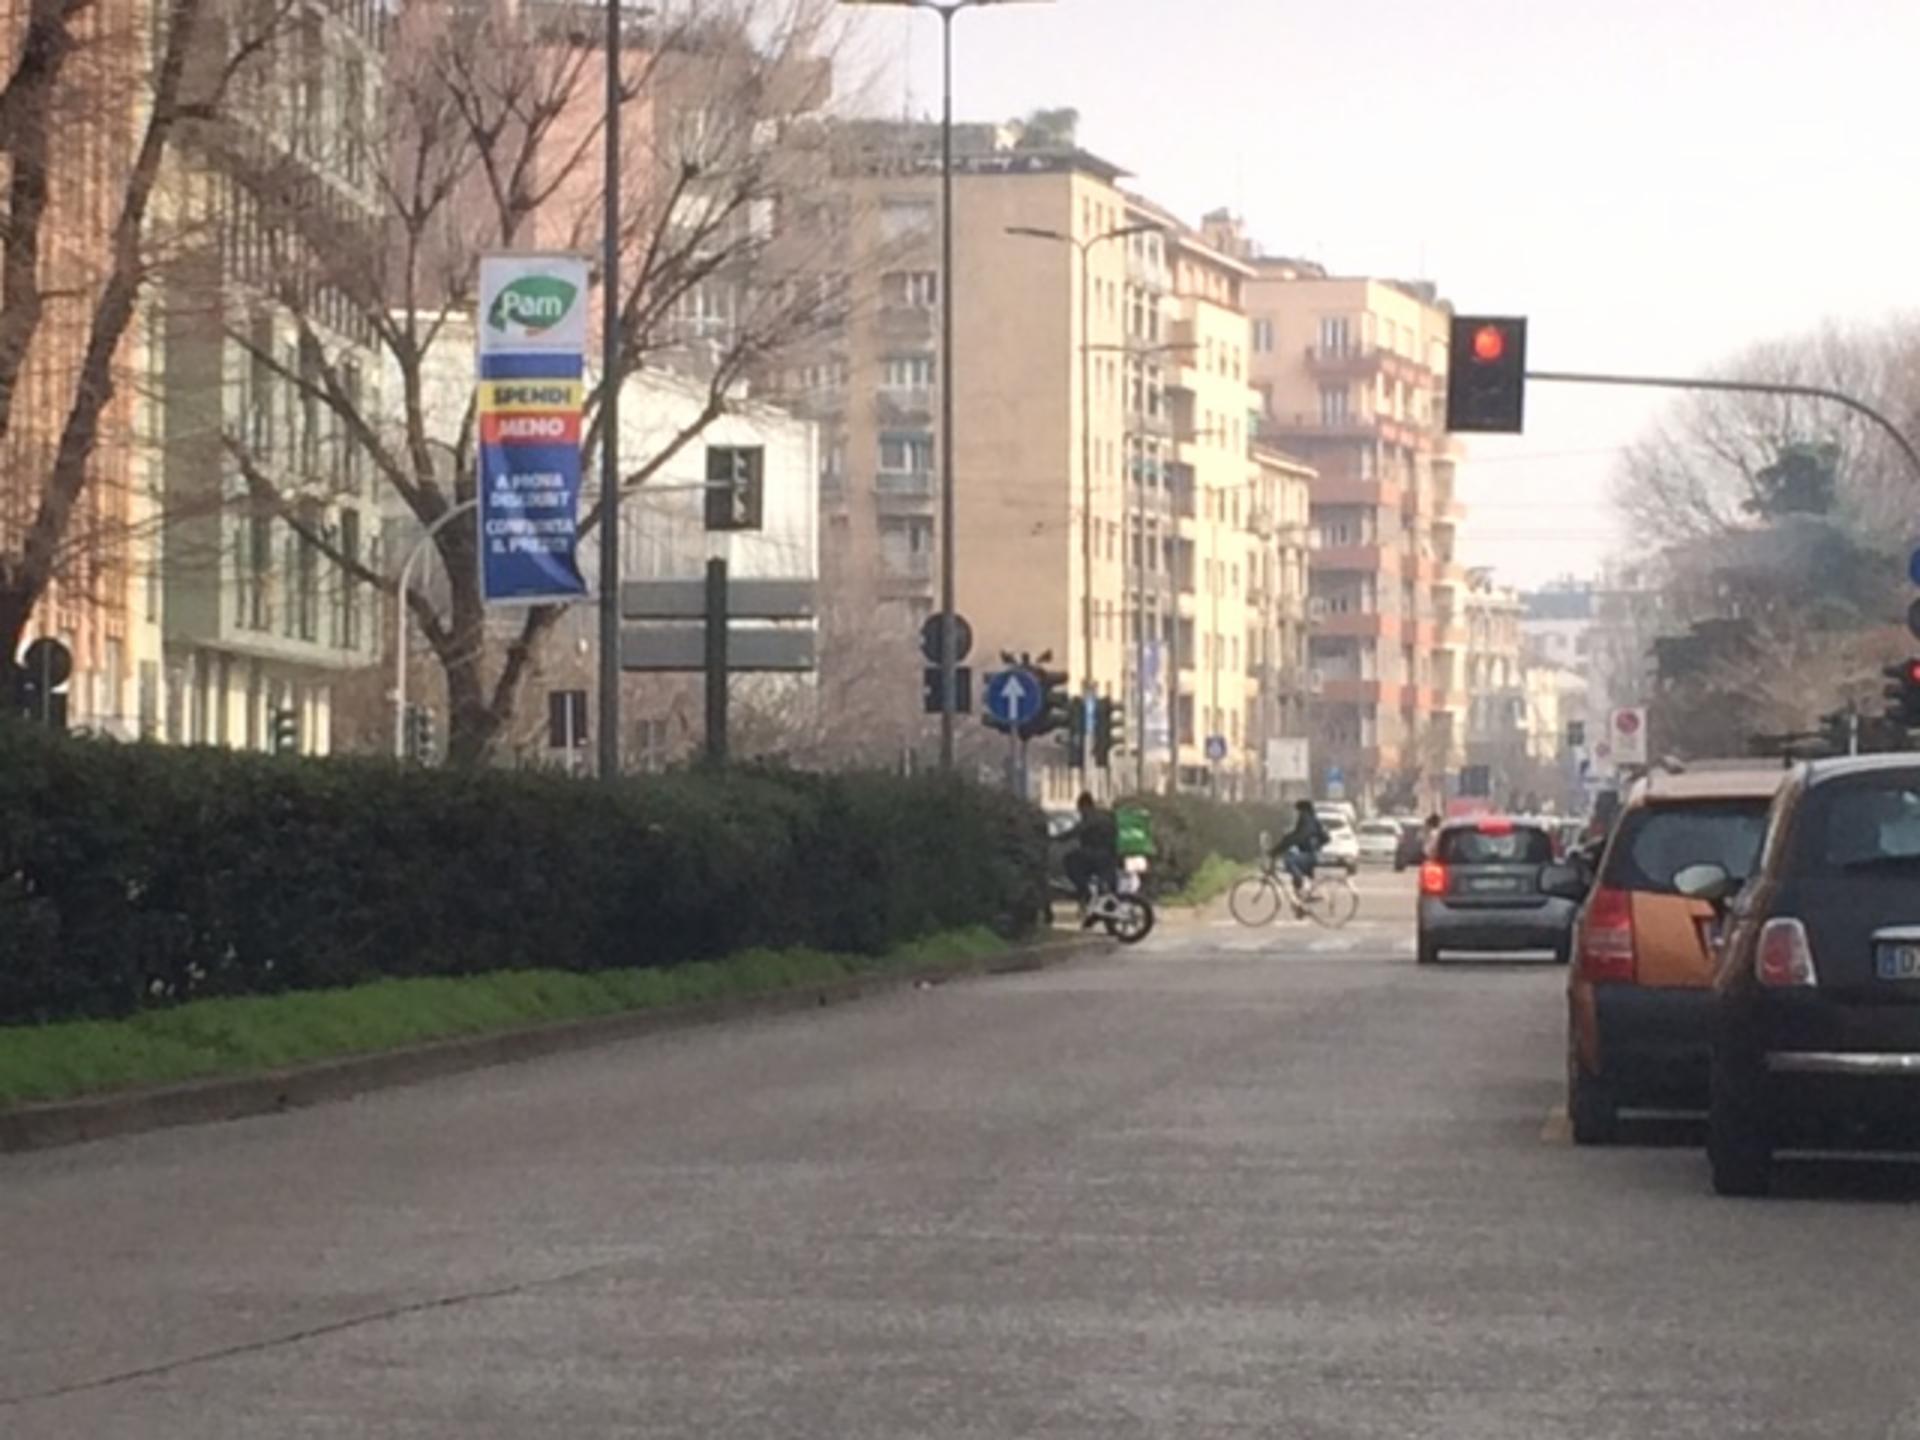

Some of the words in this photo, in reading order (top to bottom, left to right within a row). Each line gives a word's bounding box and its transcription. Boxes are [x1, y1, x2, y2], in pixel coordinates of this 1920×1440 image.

[501, 290, 562, 319] Pam
[494, 385, 570, 405] SPENDI
[498, 416, 565, 436] MENO
